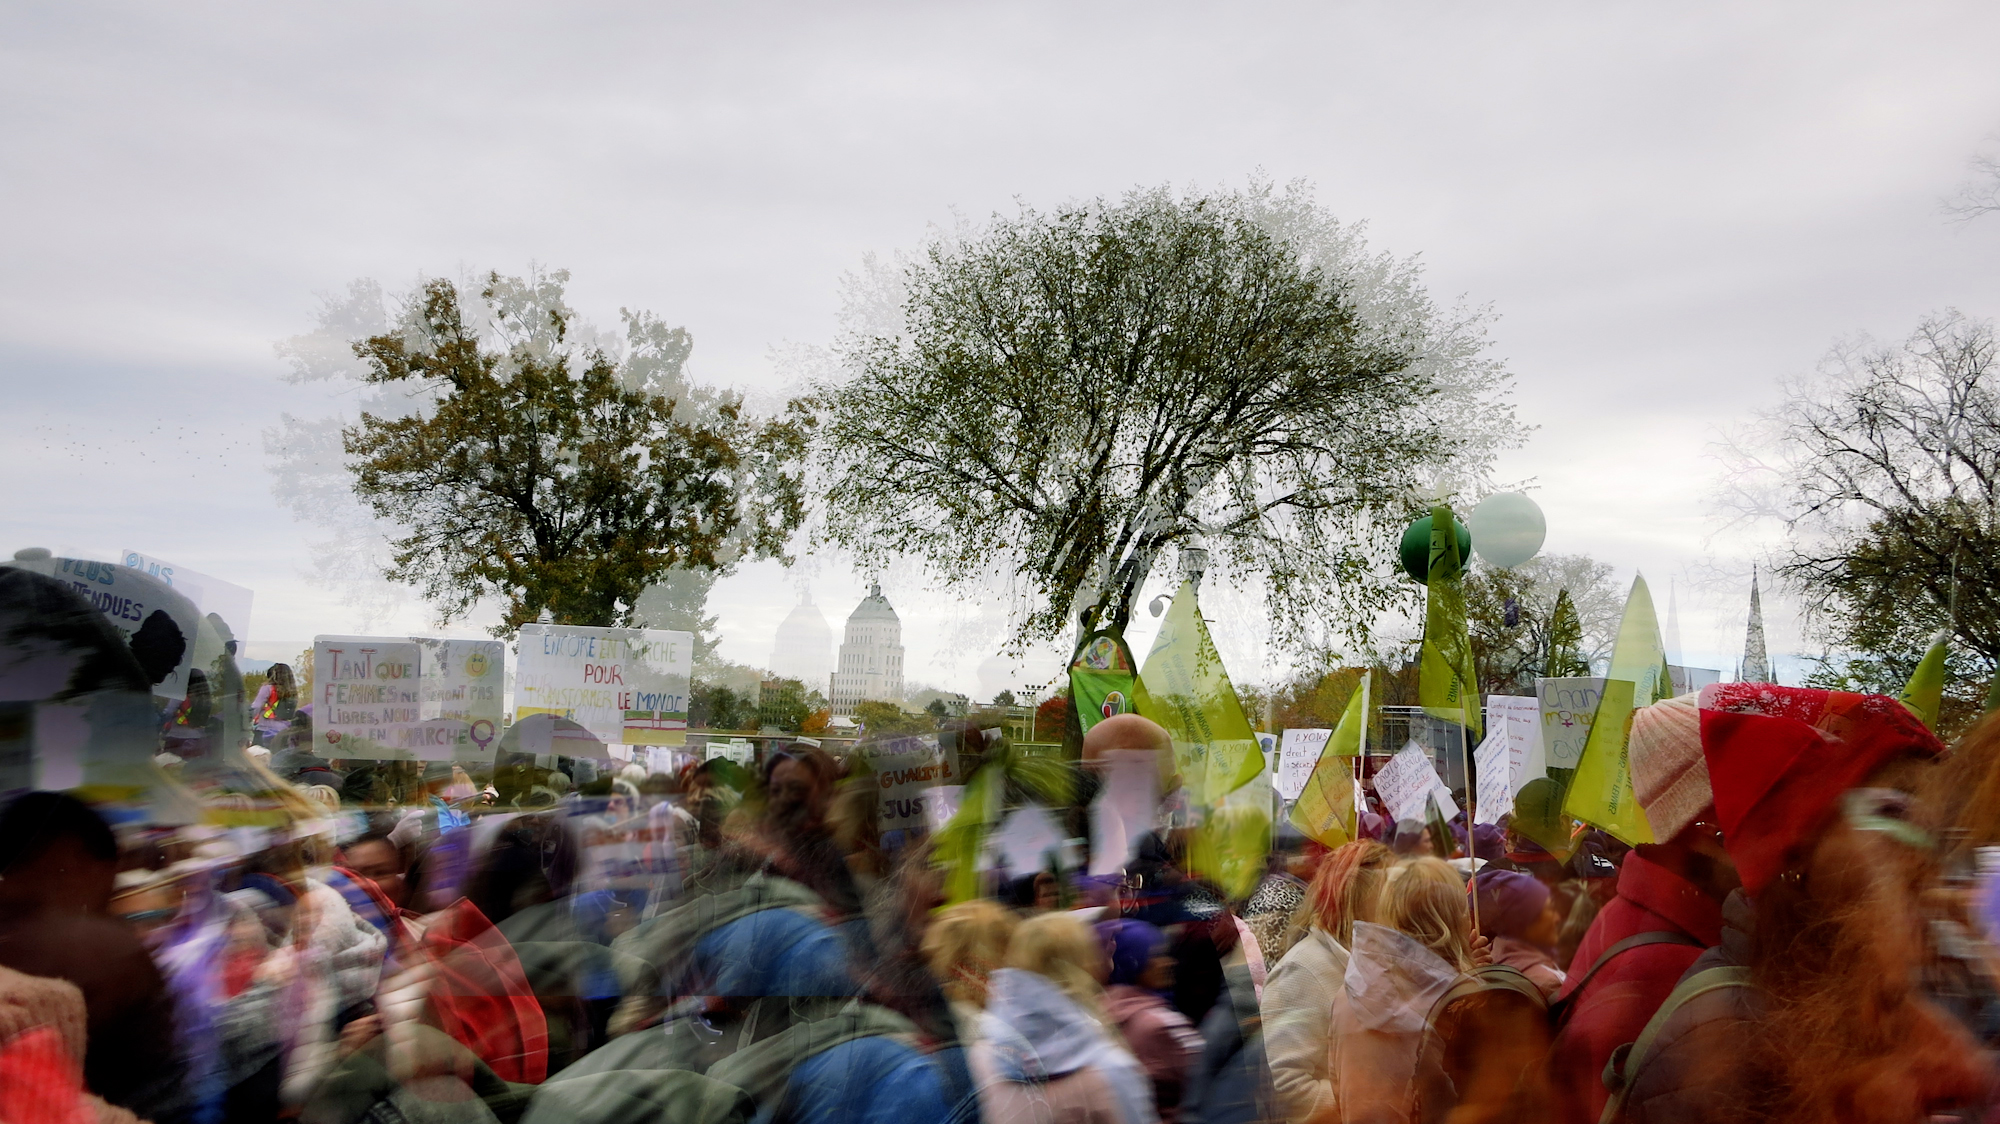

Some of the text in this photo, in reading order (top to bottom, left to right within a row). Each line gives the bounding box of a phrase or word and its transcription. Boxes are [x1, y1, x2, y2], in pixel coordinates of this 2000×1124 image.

[63, 558, 115, 585] PLUS
[544, 635, 596, 657] ENCORE
[600, 638, 617, 658] EN
[623, 638, 677, 663] MARCHE
[375, 662, 413, 682] QUE
[584, 664, 624, 685] POUR
[325, 682, 398, 705] FEMMES
[401, 690, 418, 703] NE
[469, 686, 494, 701] PAS
[618, 692, 631, 710] LE
[636, 691, 682, 712] MONDE
[383, 708, 419, 723] NOUS
[1194, 709, 1212, 738] MAISONS
[368, 727, 468, 747] EN MARCHE
[1295, 732, 1328, 743] AYONS
[1286, 746, 1307, 757] droit
